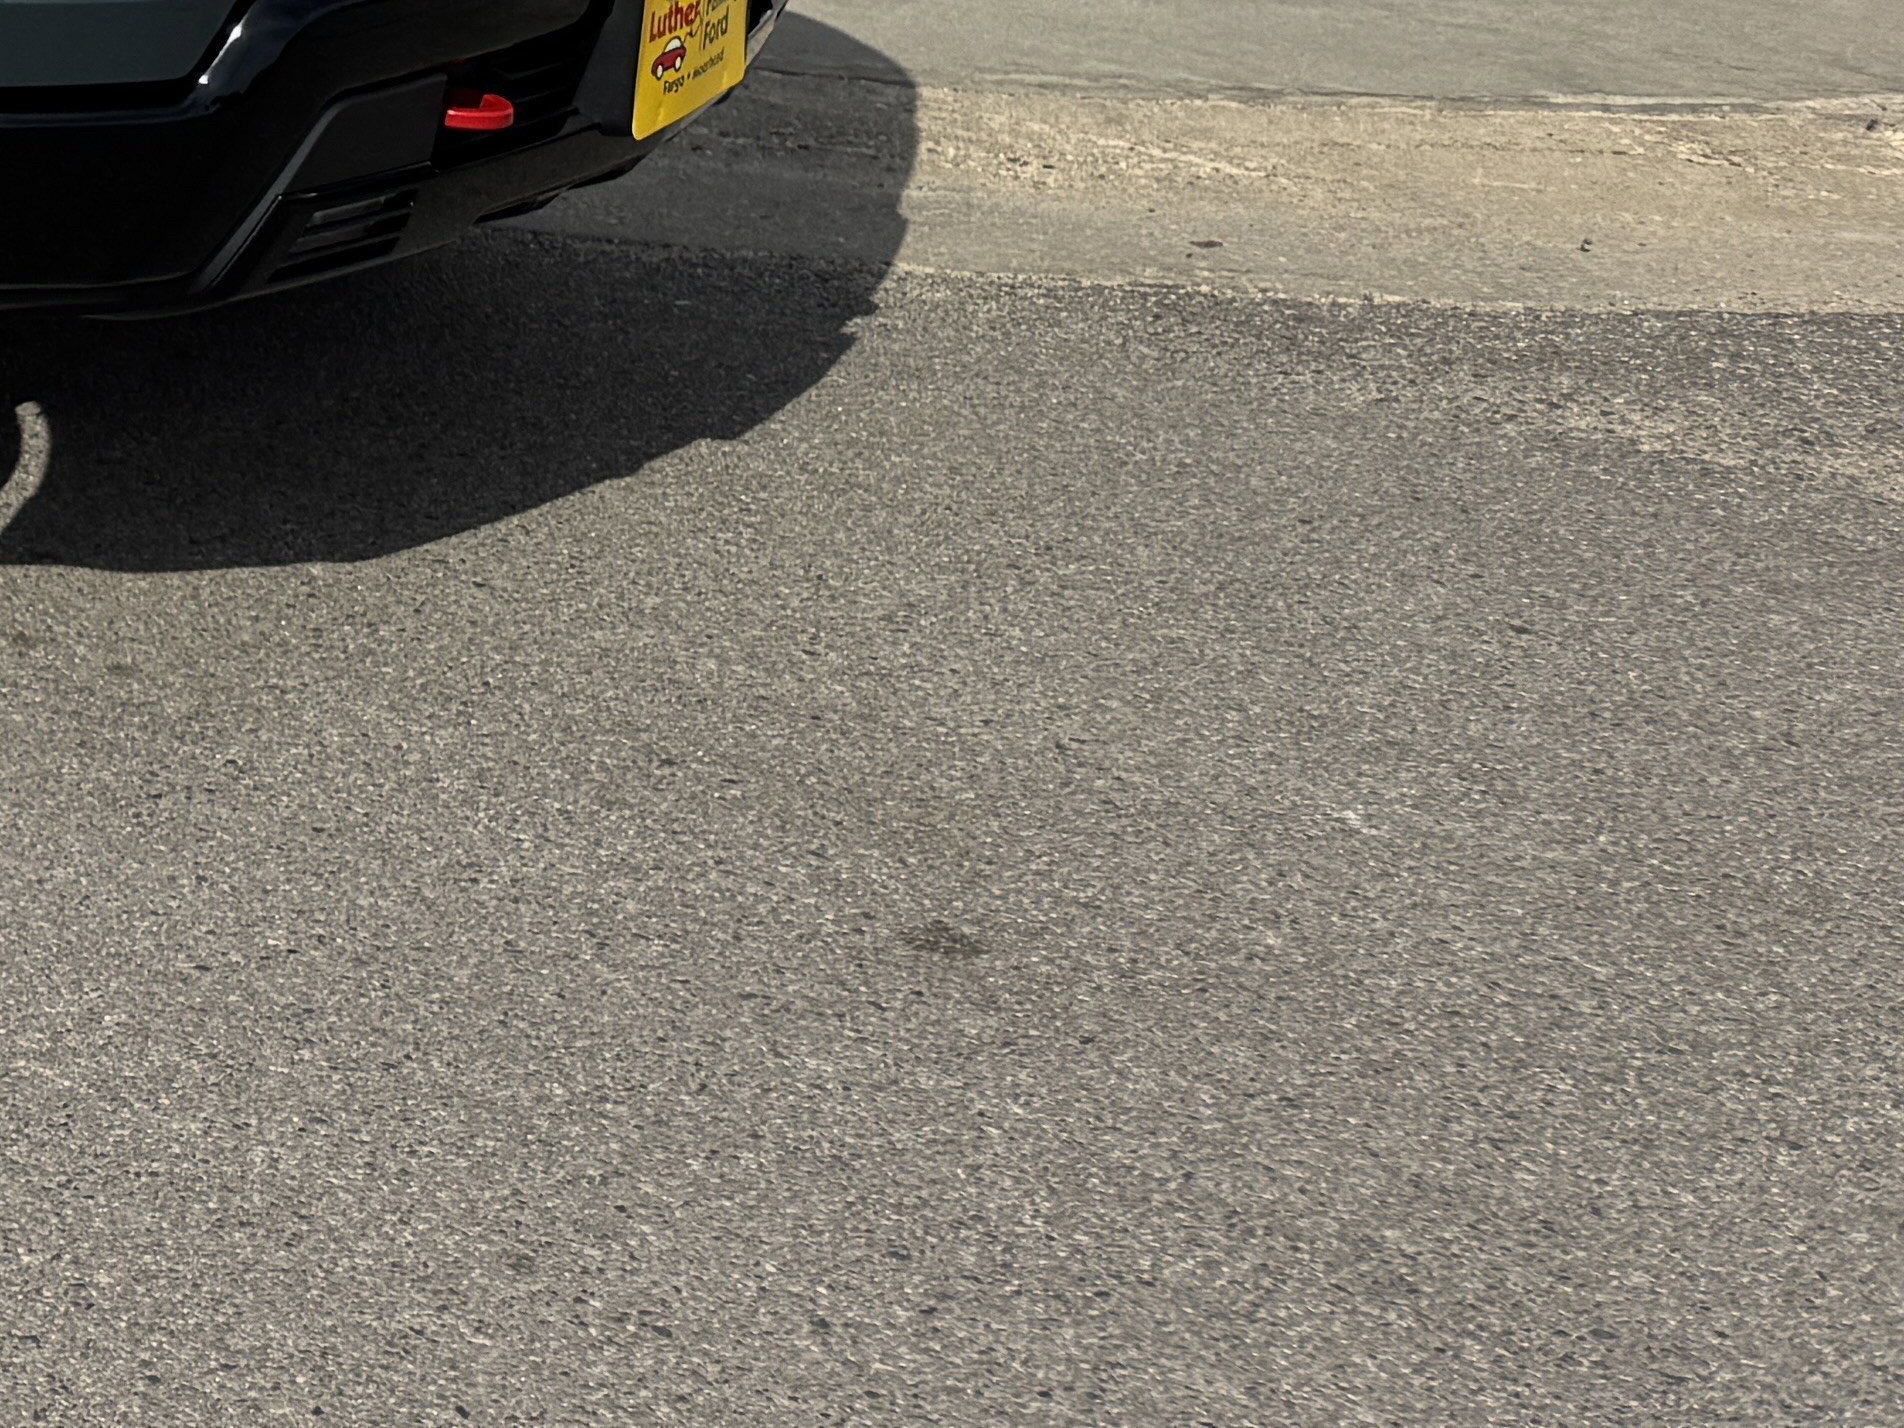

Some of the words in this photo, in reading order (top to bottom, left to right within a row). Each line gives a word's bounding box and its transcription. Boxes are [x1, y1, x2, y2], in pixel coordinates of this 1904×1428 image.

[649, 0, 702, 44] Luther
[703, 5, 730, 51] Ford
[663, 74, 685, 95] Fargo
